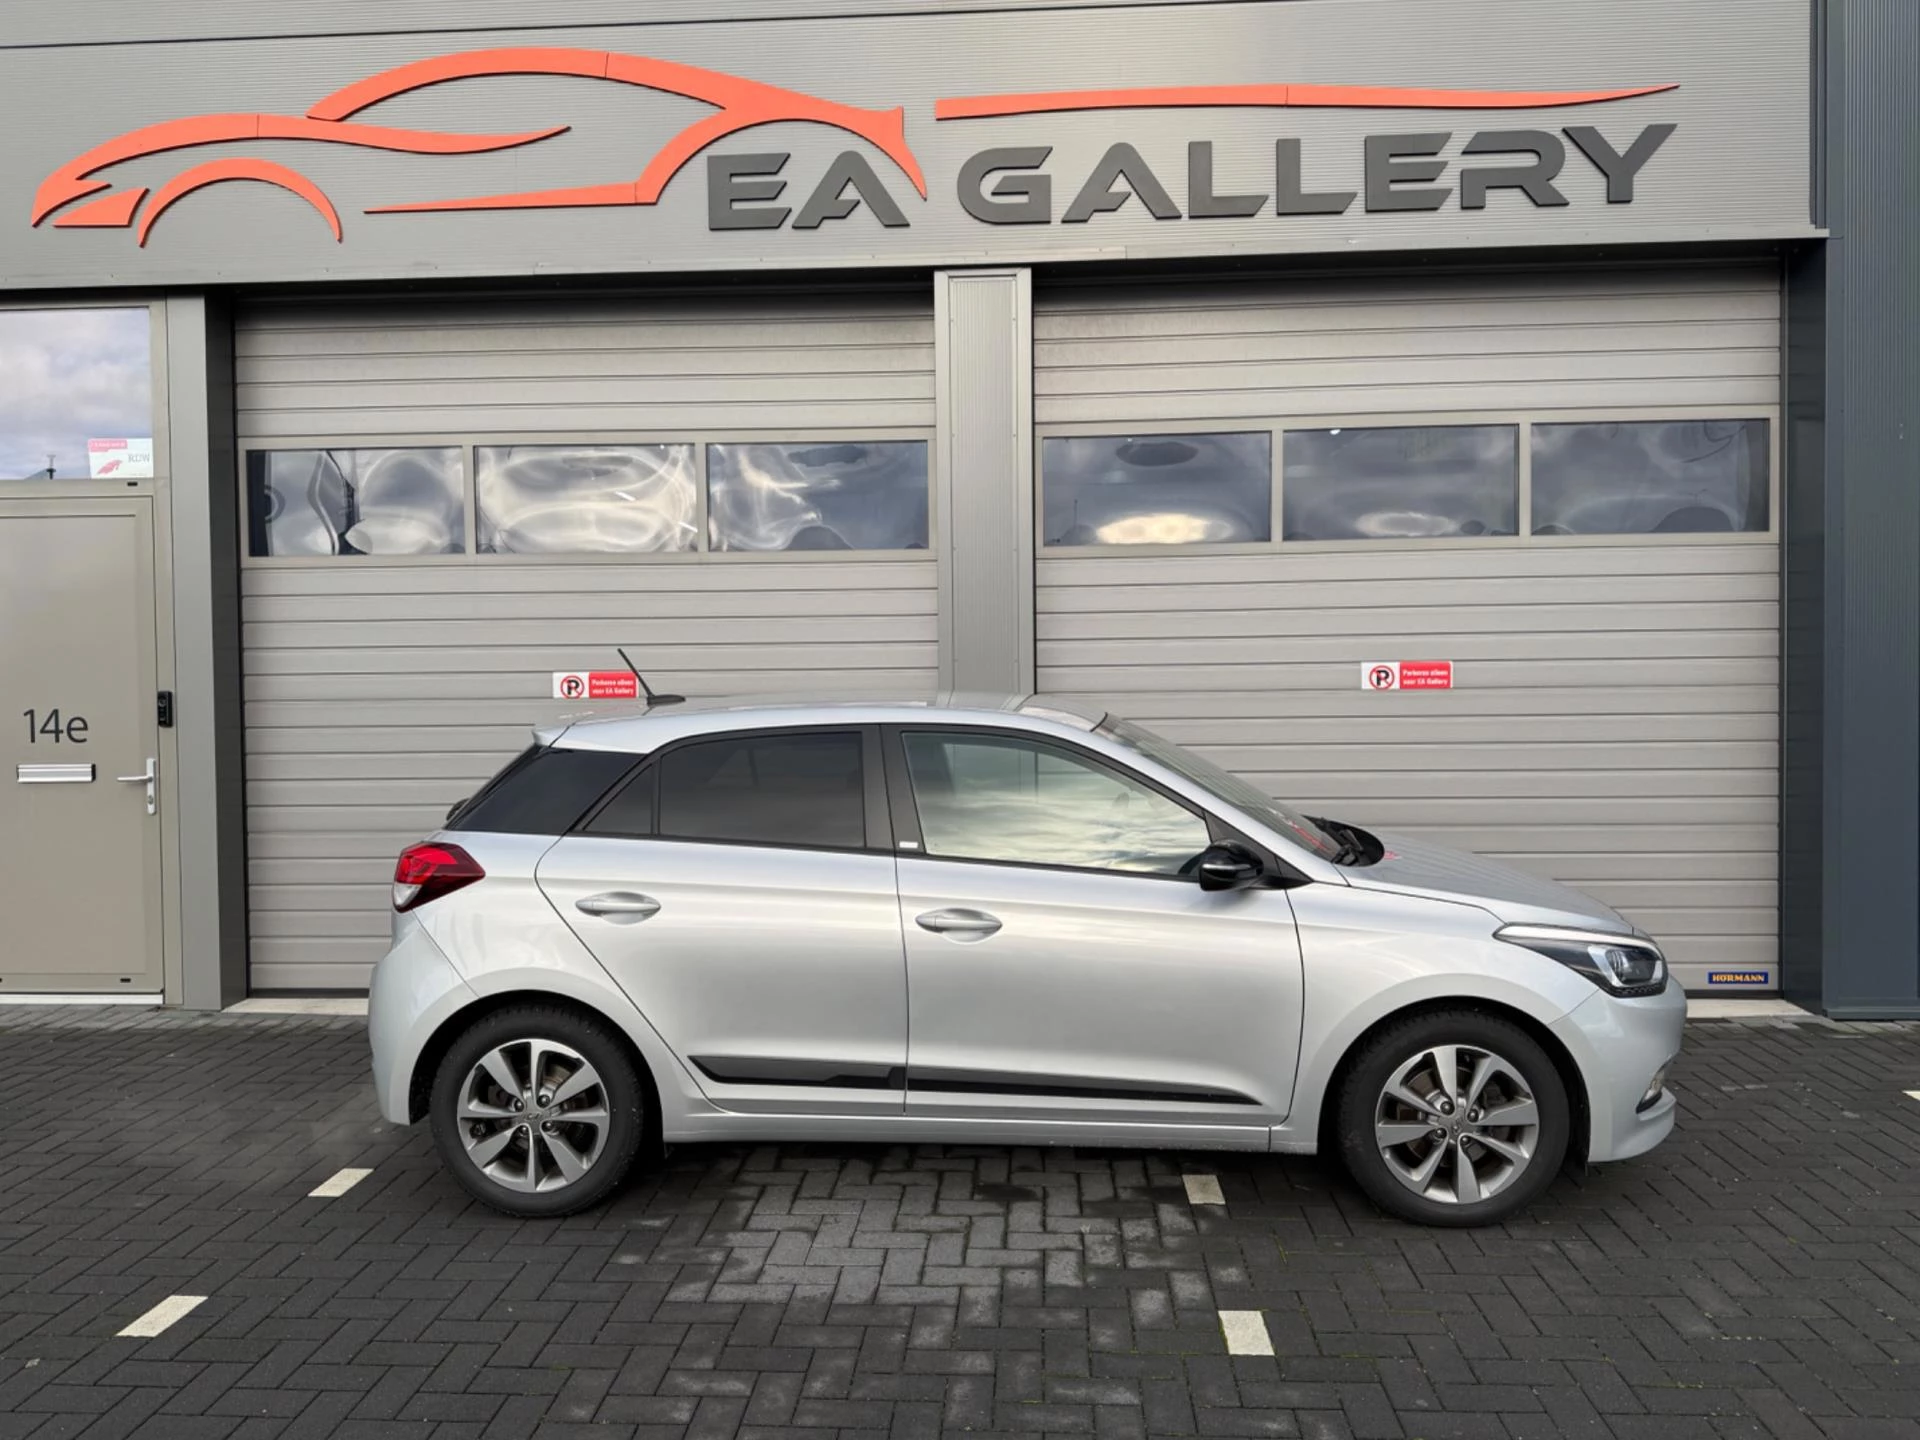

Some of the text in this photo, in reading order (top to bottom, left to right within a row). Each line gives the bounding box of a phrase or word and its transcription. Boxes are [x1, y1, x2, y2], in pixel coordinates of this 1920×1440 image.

[707, 123, 1678, 231] EA GALLERY
[23, 708, 88, 743] 14e
